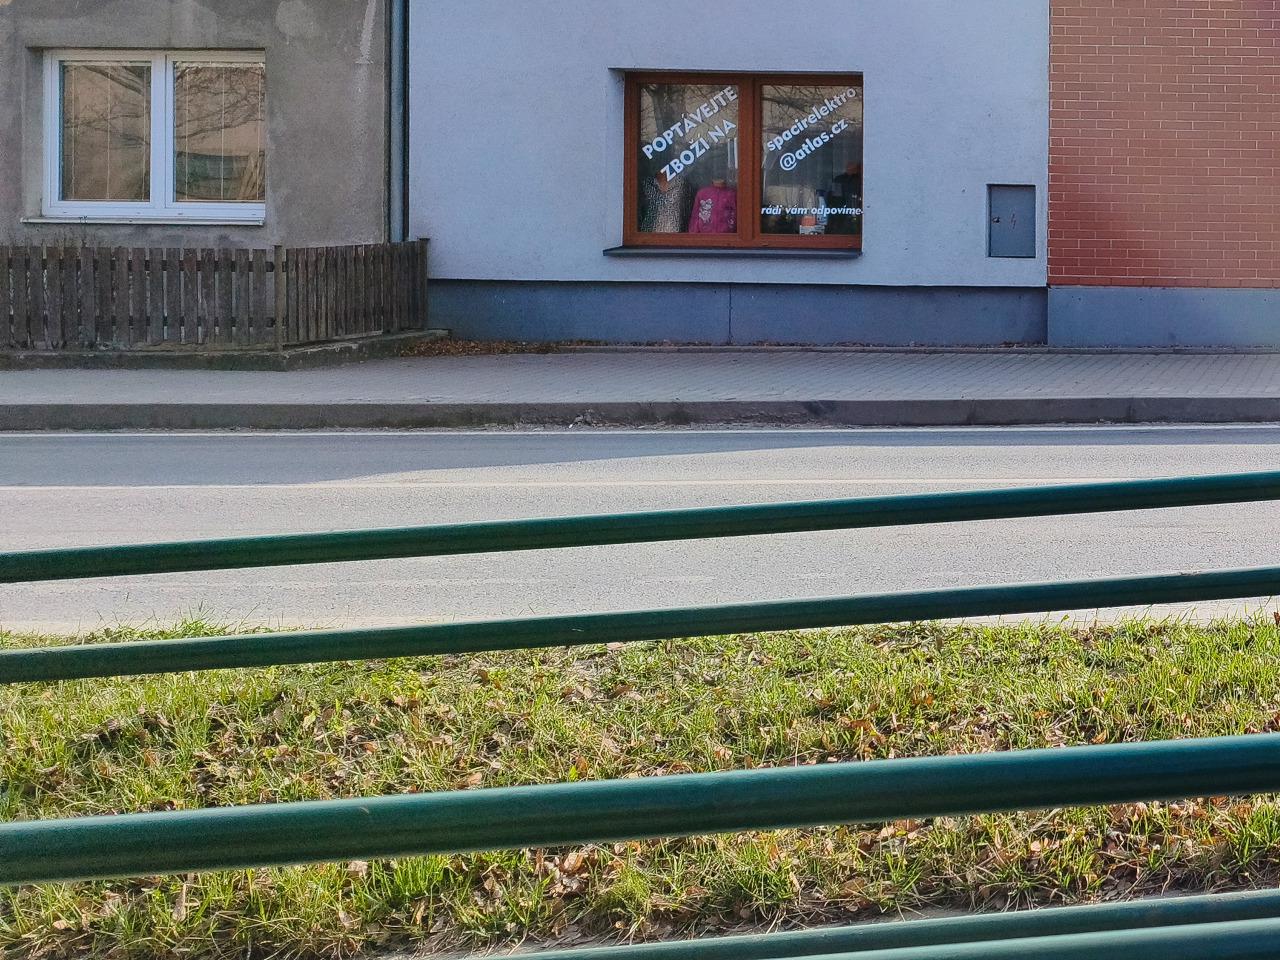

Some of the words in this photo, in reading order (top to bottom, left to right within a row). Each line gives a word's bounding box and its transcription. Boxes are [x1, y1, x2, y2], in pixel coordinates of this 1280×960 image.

[641, 86, 738, 160] POPTÁVEJTE
[660, 133, 710, 181] ZBOŽÍ
[708, 119, 737, 143] NA
[767, 88, 856, 152] spacirelektro
[780, 118, 849, 171] @atlas.cz
[761, 203, 782, 216] rádi
[785, 203, 807, 216] vám
